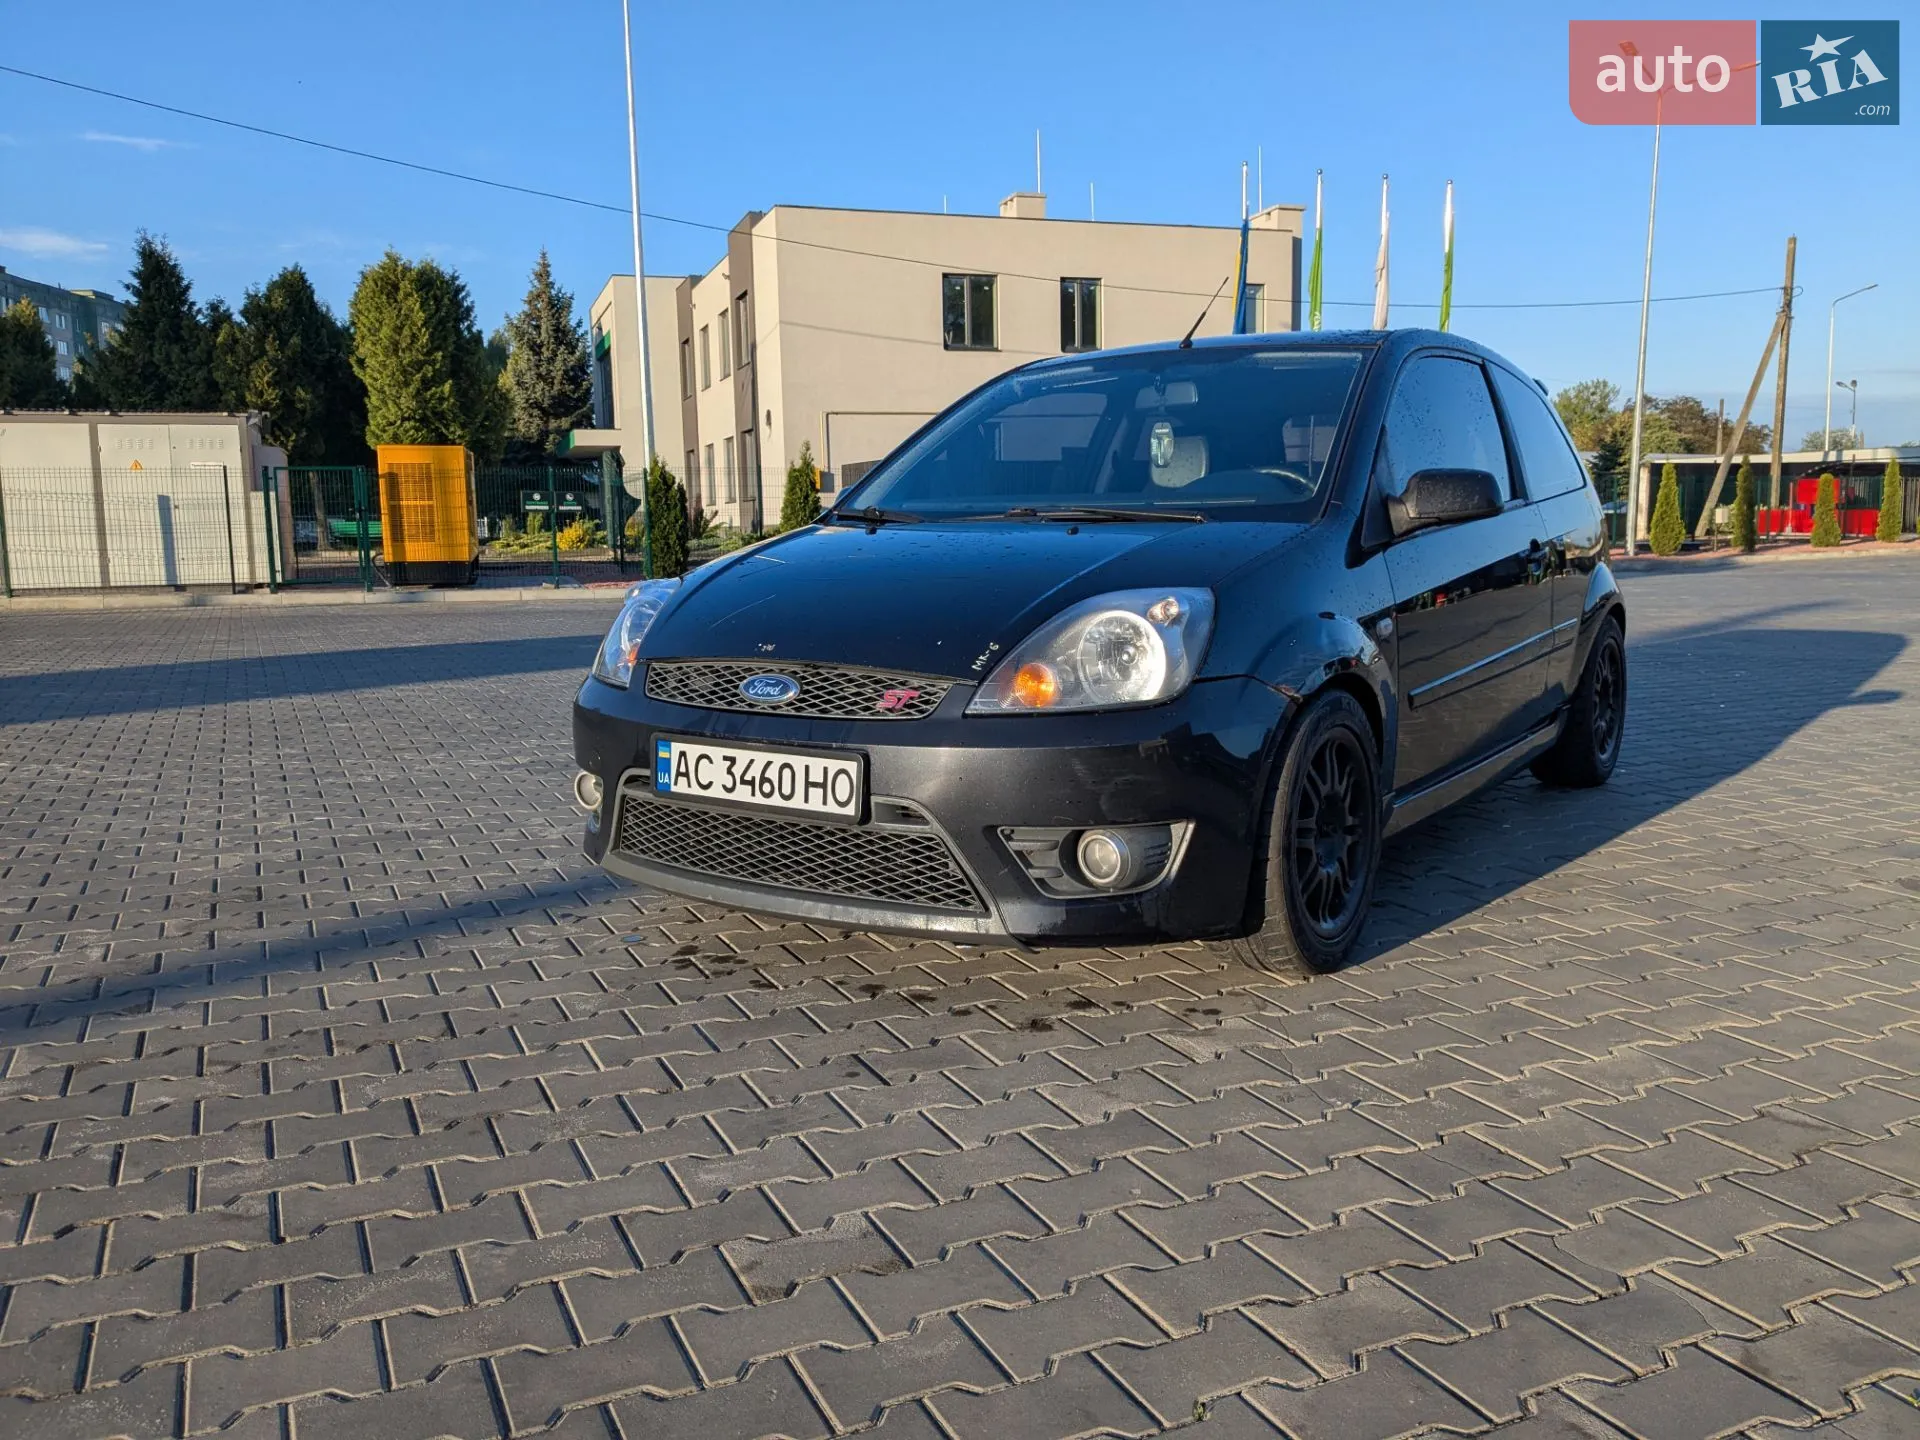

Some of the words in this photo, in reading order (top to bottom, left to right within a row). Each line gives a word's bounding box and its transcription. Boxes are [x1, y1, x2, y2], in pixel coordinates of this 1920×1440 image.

[749, 679, 782, 696] Ford
[875, 689, 920, 712] ST
[658, 772, 670, 784] UA
[673, 750, 714, 791] AC
[721, 755, 796, 801] 3460
[804, 764, 855, 808] HO
